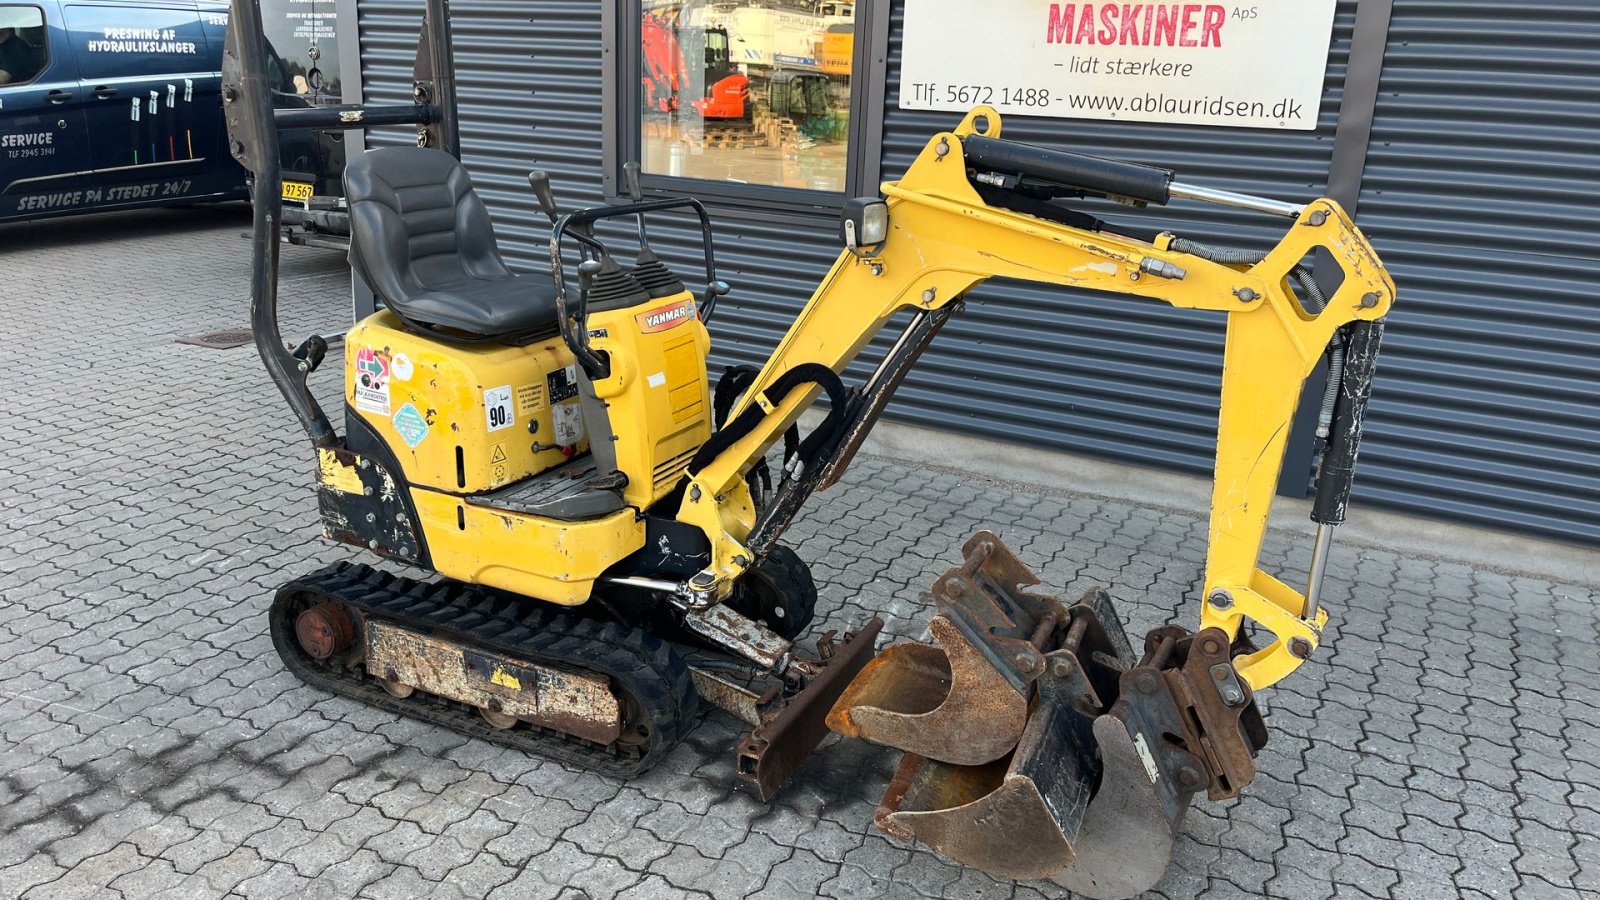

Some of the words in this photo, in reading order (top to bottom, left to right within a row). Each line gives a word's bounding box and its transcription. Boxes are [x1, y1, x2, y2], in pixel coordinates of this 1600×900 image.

[208, 15, 229, 26] SERV
[1047, 3, 1226, 48] MASKINER
[1231, 7, 1258, 21] ApS
[103, 27, 160, 40] PRESNING
[162, 29, 176, 41] AF
[88, 40, 196, 54] HYDRAULIKSLANGER
[1069, 56, 1100, 74] lidt
[1105, 58, 1193, 77] stærkere
[912, 83, 939, 106] Tlf.
[946, 84, 994, 104] 5672
[1000, 87, 1050, 107] 1488
[1069, 92, 1302, 119] www.ablauridsen.dk
[1, 132, 53, 148] SERVICE
[8, 150, 20, 159] TLF
[21, 148, 39, 158] 2945
[17, 191, 83, 211] SERVICE
[106, 183, 159, 201] STEDET
[161, 179, 192, 196] 24/7
[285, 184, 296, 196] 97
[296, 185, 312, 198] 567
[645, 307, 686, 327] YANMAR
[490, 405, 505, 427] 90
